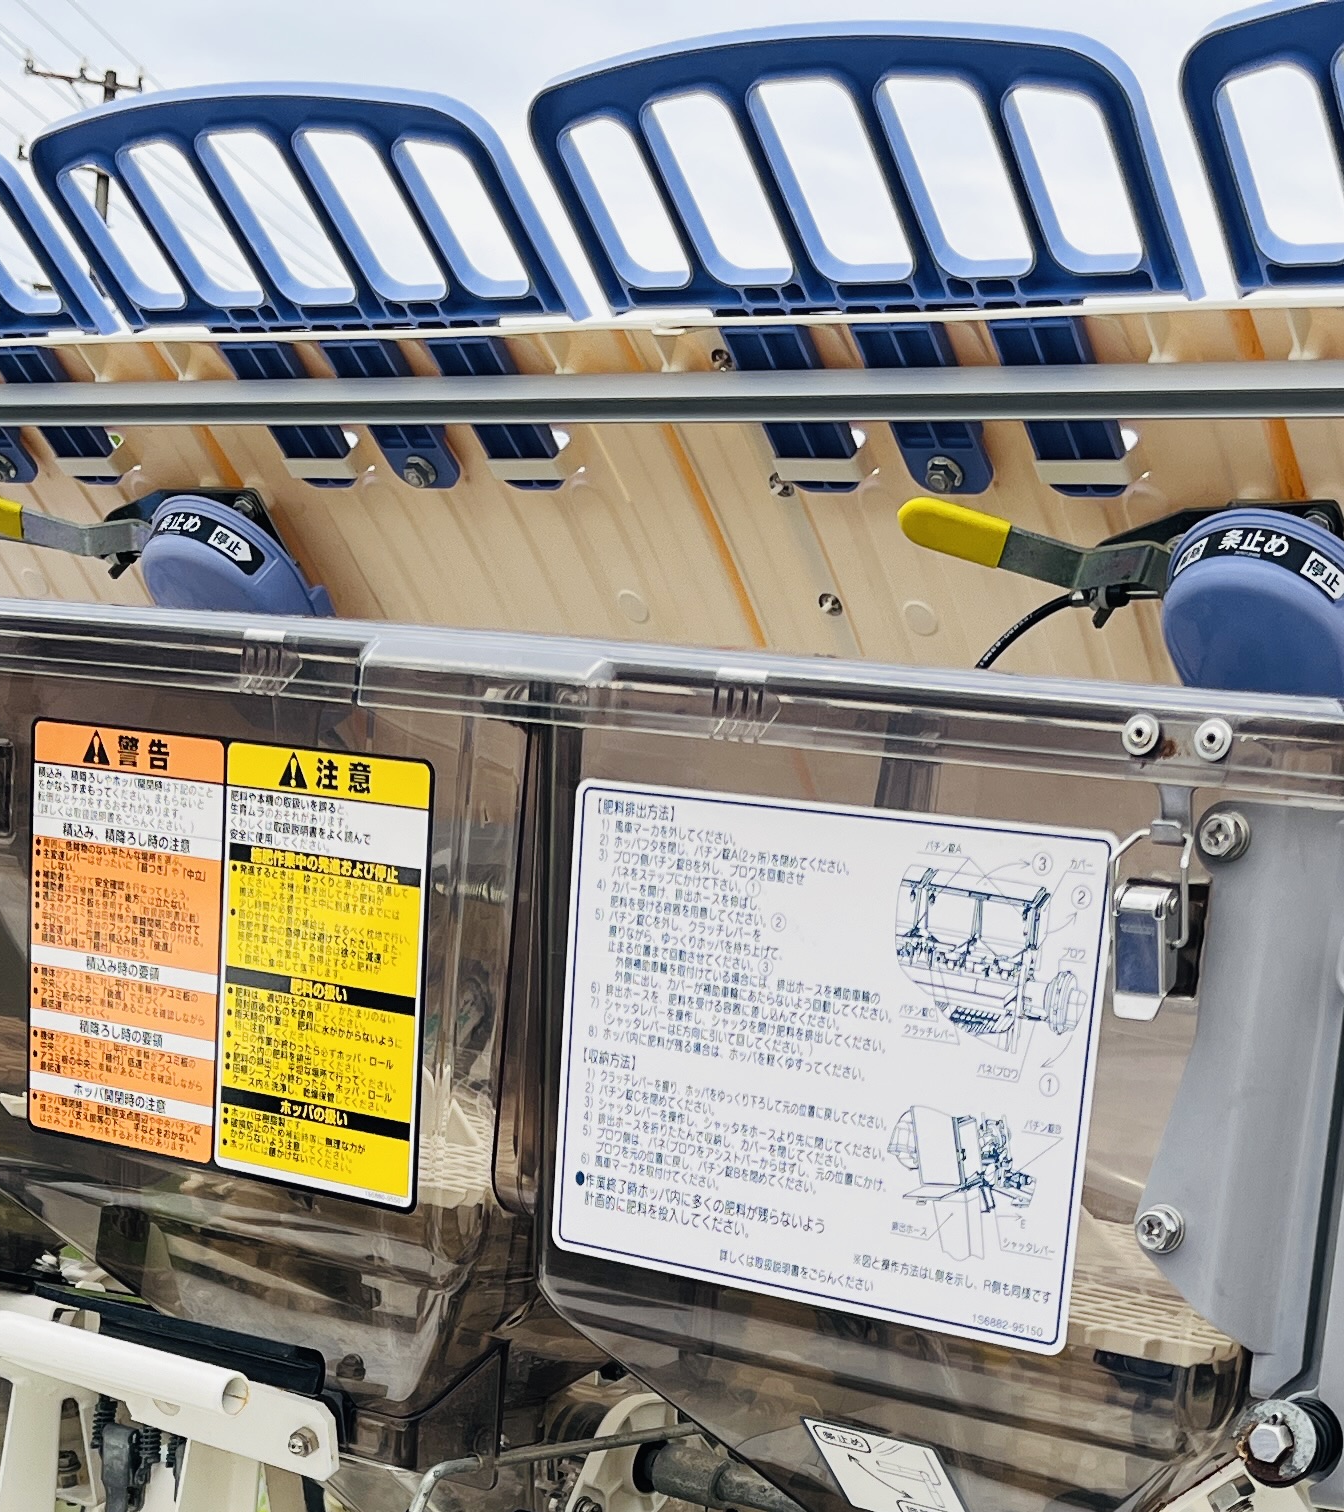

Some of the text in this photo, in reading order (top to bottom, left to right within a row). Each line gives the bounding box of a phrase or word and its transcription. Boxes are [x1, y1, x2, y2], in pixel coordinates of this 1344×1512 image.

[214, 530, 242, 556] 停止
[1218, 528, 1289, 557] 条止め
[1306, 558, 1342, 593] 停止
[117, 734, 170, 771] 警告
[315, 757, 372, 794] 注意
[597, 798, 674, 822] 【肥料排出方法】
[86, 955, 159, 981] 積込み時の要領
[289, 977, 347, 1003] 肥料の扱い
[79, 1019, 162, 1048] 積降ろし時の要領
[583, 1047, 636, 1071] 【収納方法】
[73, 1082, 166, 1114] ホッパ開閉時の注意
[279, 1099, 348, 1128] ホッパの扱い
